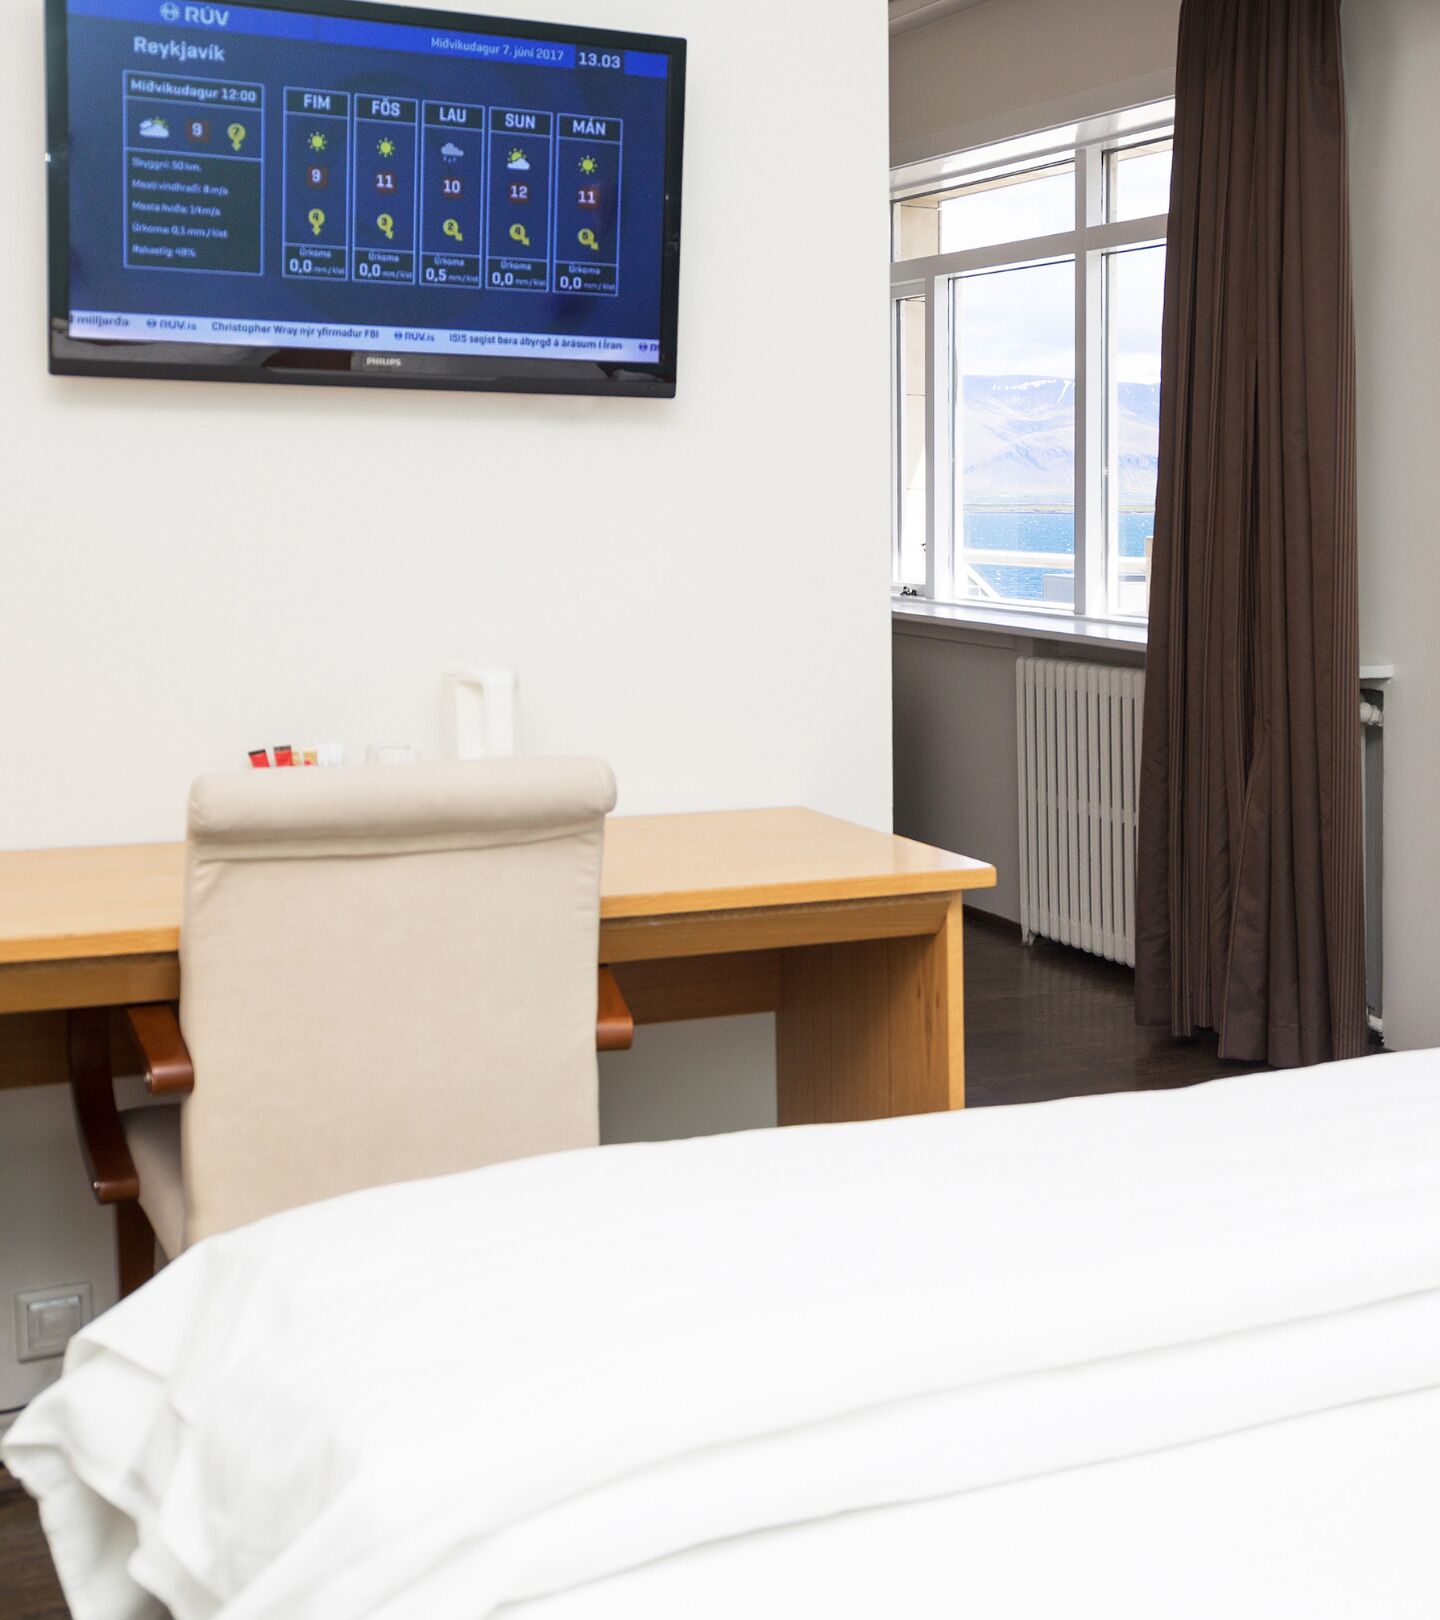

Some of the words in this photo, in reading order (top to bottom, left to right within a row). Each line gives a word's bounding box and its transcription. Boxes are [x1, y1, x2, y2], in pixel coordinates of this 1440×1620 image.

[536, 48, 564, 60] 2017
[579, 52, 621, 69] 13.03
[221, 88, 257, 102] 12:00
[303, 93, 331, 110] FIM
[439, 107, 467, 123] LAU
[505, 113, 536, 129] SUN
[573, 118, 606, 135] MÁN
[376, 174, 394, 188] 11
[444, 180, 461, 194] 10
[510, 185, 528, 199] 12
[578, 190, 596, 204] 11
[289, 258, 312, 274] 0,0
[359, 263, 381, 279] 0,0
[425, 267, 447, 283] 0,5
[492, 272, 514, 288] 0,0
[560, 275, 582, 291] 0,0
[273, 323, 298, 337] Wray
[366, 356, 401, 367] PHILIPS
